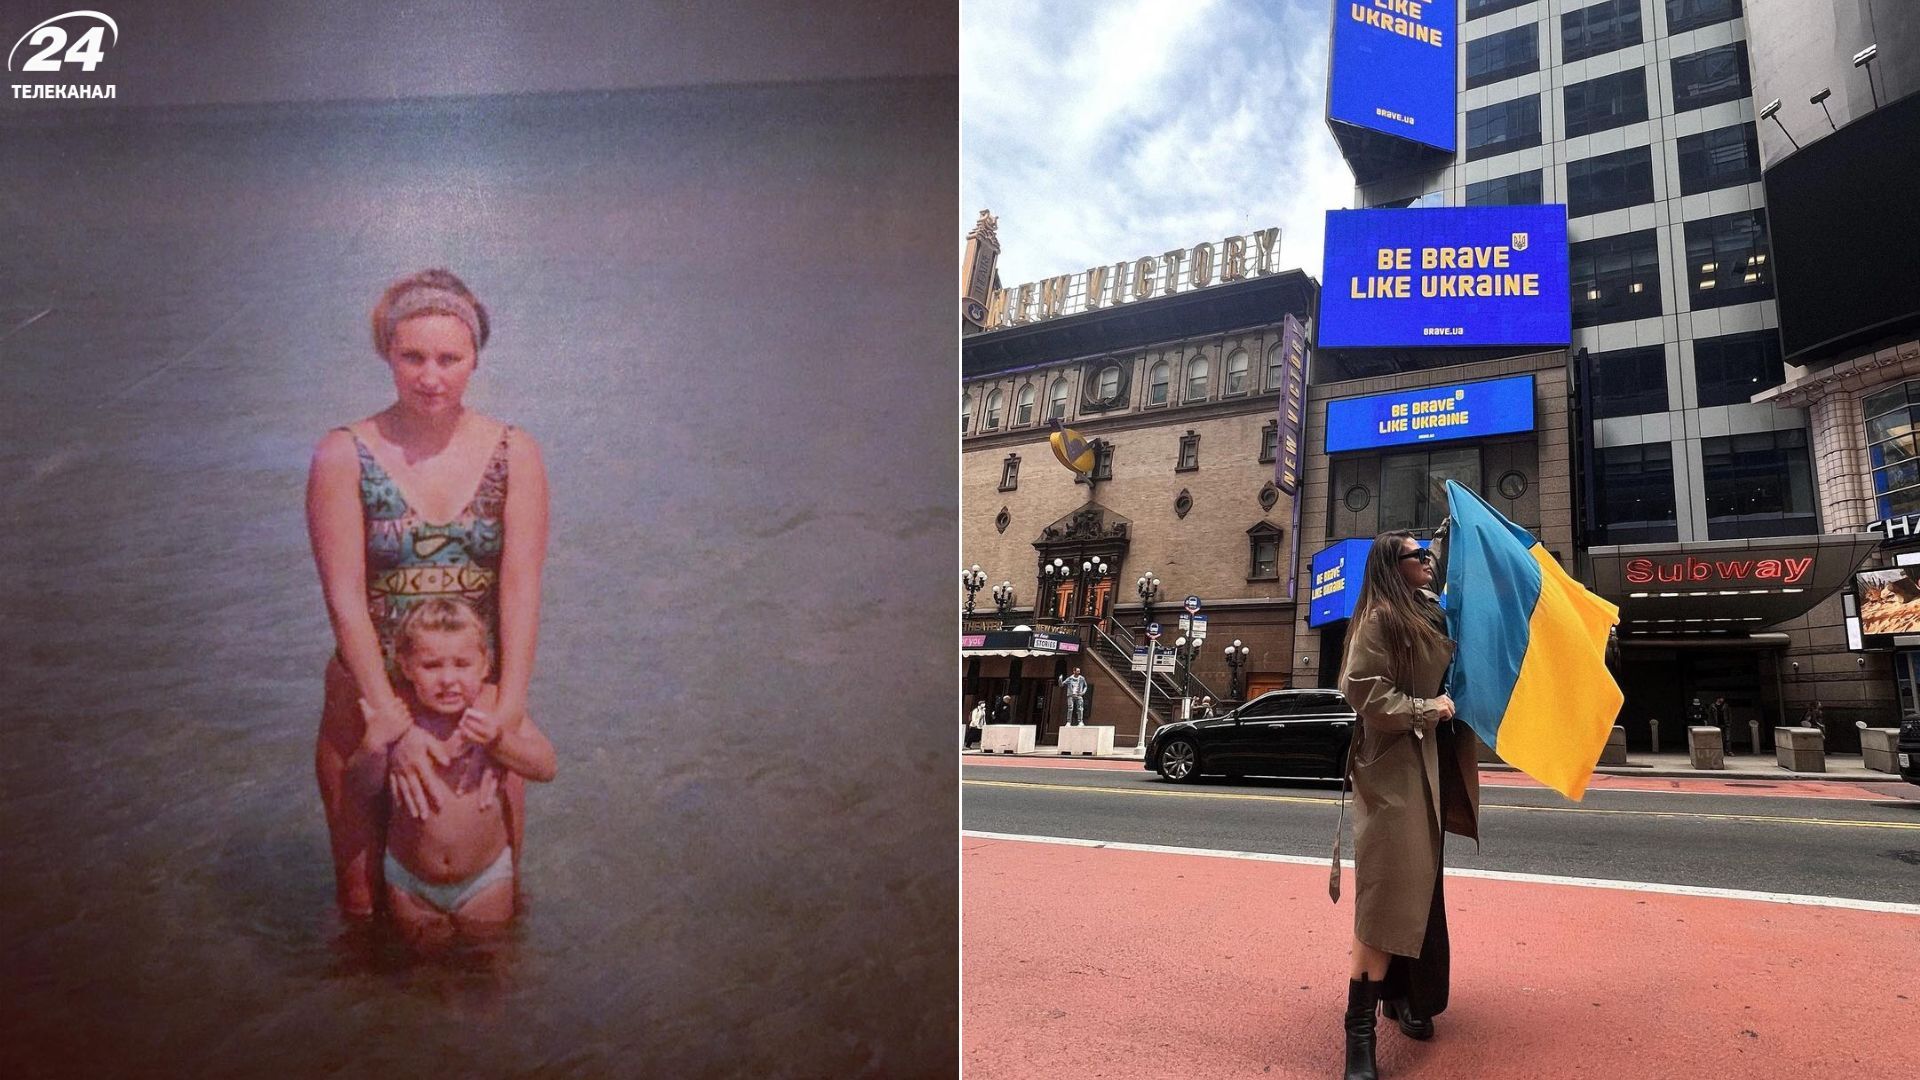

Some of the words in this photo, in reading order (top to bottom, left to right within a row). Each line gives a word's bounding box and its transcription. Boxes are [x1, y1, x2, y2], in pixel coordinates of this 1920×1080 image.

[1378, 248, 1411, 270] BE
[986, 273, 1072, 331] NEW
[1084, 227, 1280, 310] VICTORY
[1351, 276, 1411, 299] LIKE
[1287, 323, 1303, 425] VICTORY
[1391, 404, 1408, 418] BE
[1379, 419, 1408, 434] LIKE
[1283, 434, 1298, 488] NEW
[1626, 556, 1813, 583] Subway
